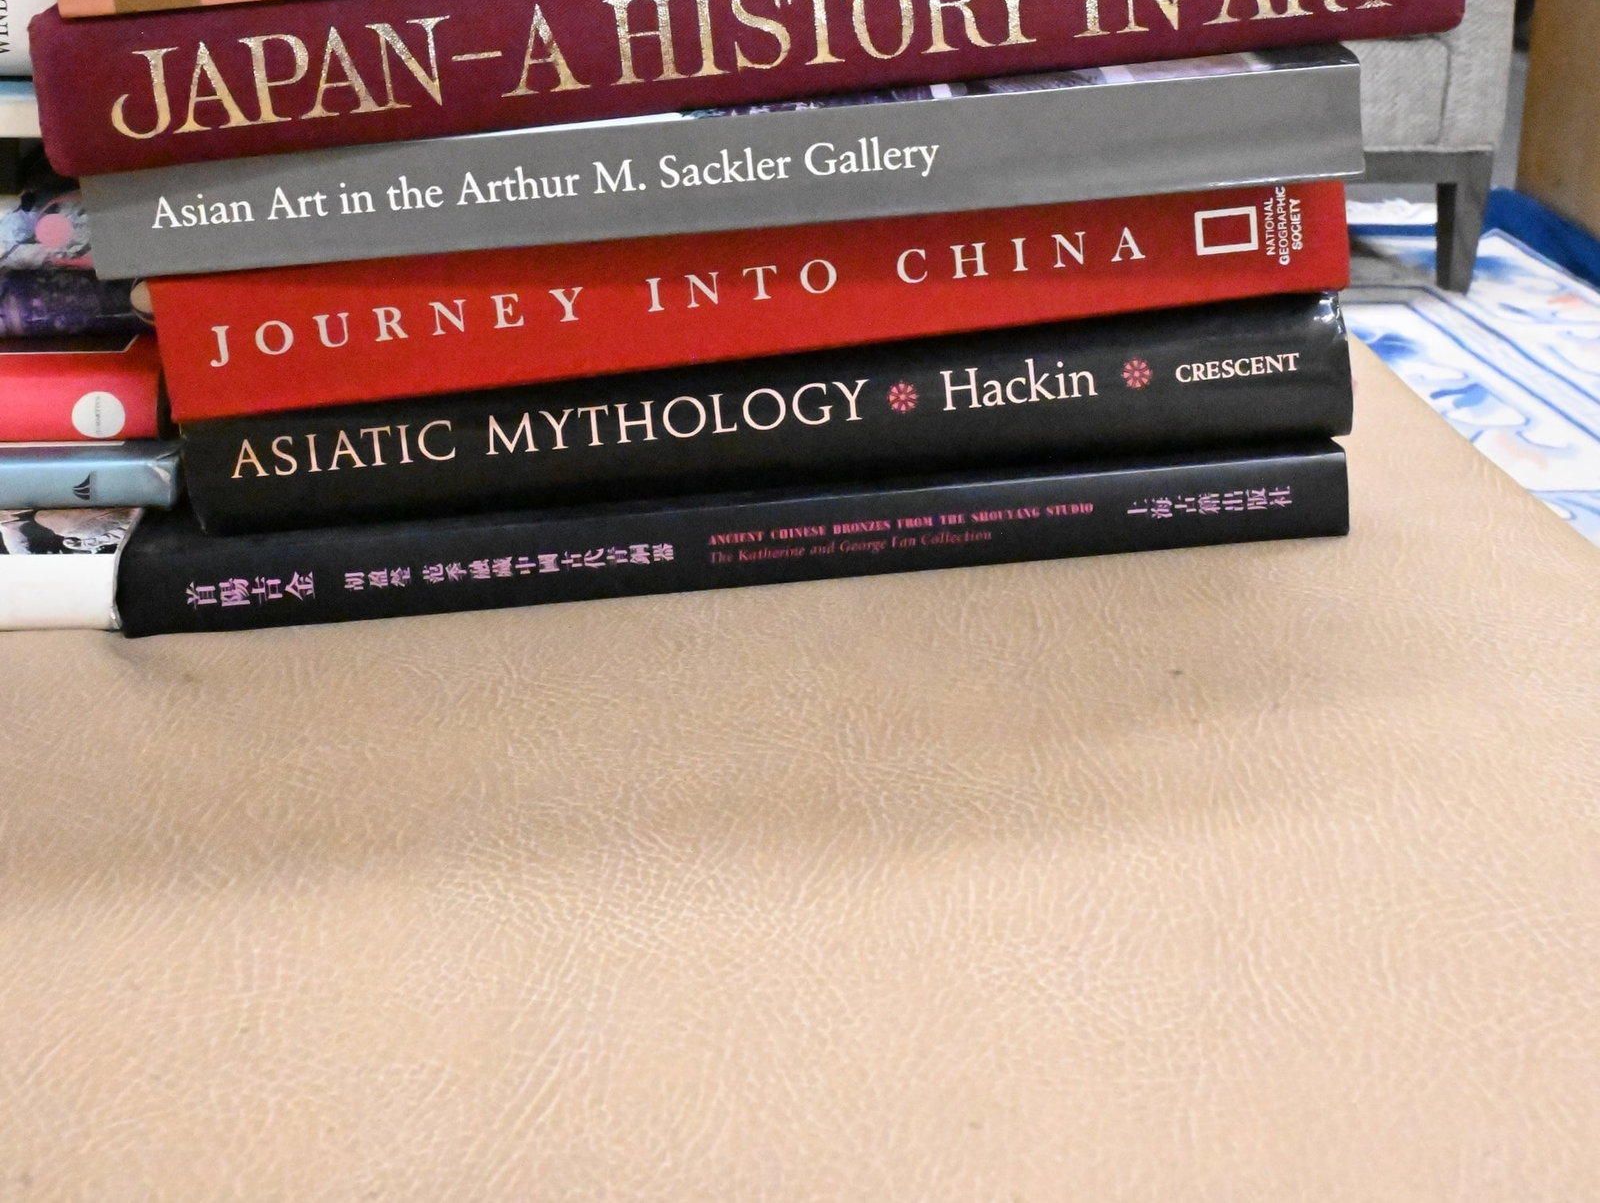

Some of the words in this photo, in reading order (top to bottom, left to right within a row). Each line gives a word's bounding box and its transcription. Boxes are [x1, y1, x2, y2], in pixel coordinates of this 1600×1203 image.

[151, 195, 255, 231] Asian
[266, 185, 327, 220] Art
[339, 182, 374, 215] in
[386, 177, 444, 212] the
[456, 164, 580, 207] Arthur
[592, 158, 647, 196] M.
[659, 148, 791, 191] Sackler
[803, 135, 940, 180] Gallery
[1265, 197, 1276, 255] NATIONAL
[1276, 186, 1290, 266] GEOGRAPHIC
[1291, 198, 1303, 250] SOCIETY
[208, 285, 584, 370] JOURNEY
[645, 257, 839, 313] INTO
[895, 225, 1146, 285] CHINA
[230, 418, 456, 481] ASIATIC
[485, 377, 869, 457] MYTHOLOGY
[939, 358, 1098, 411] Hackin
[1174, 351, 1301, 383] CRESCENT
[708, 531, 764, 546] ANCIENT
[770, 525, 827, 540] CHINESE
[832, 519, 891, 535] BRONZES
[897, 516, 933, 529] FROM
[940, 513, 966, 525] THE
[971, 506, 1040, 523] SHOUYANG
[1046, 502, 1094, 516] STUDIO
[710, 552, 732, 564] The
[810, 542, 835, 555] and
[839, 538, 886, 554] George
[920, 531, 992, 545] Collection
